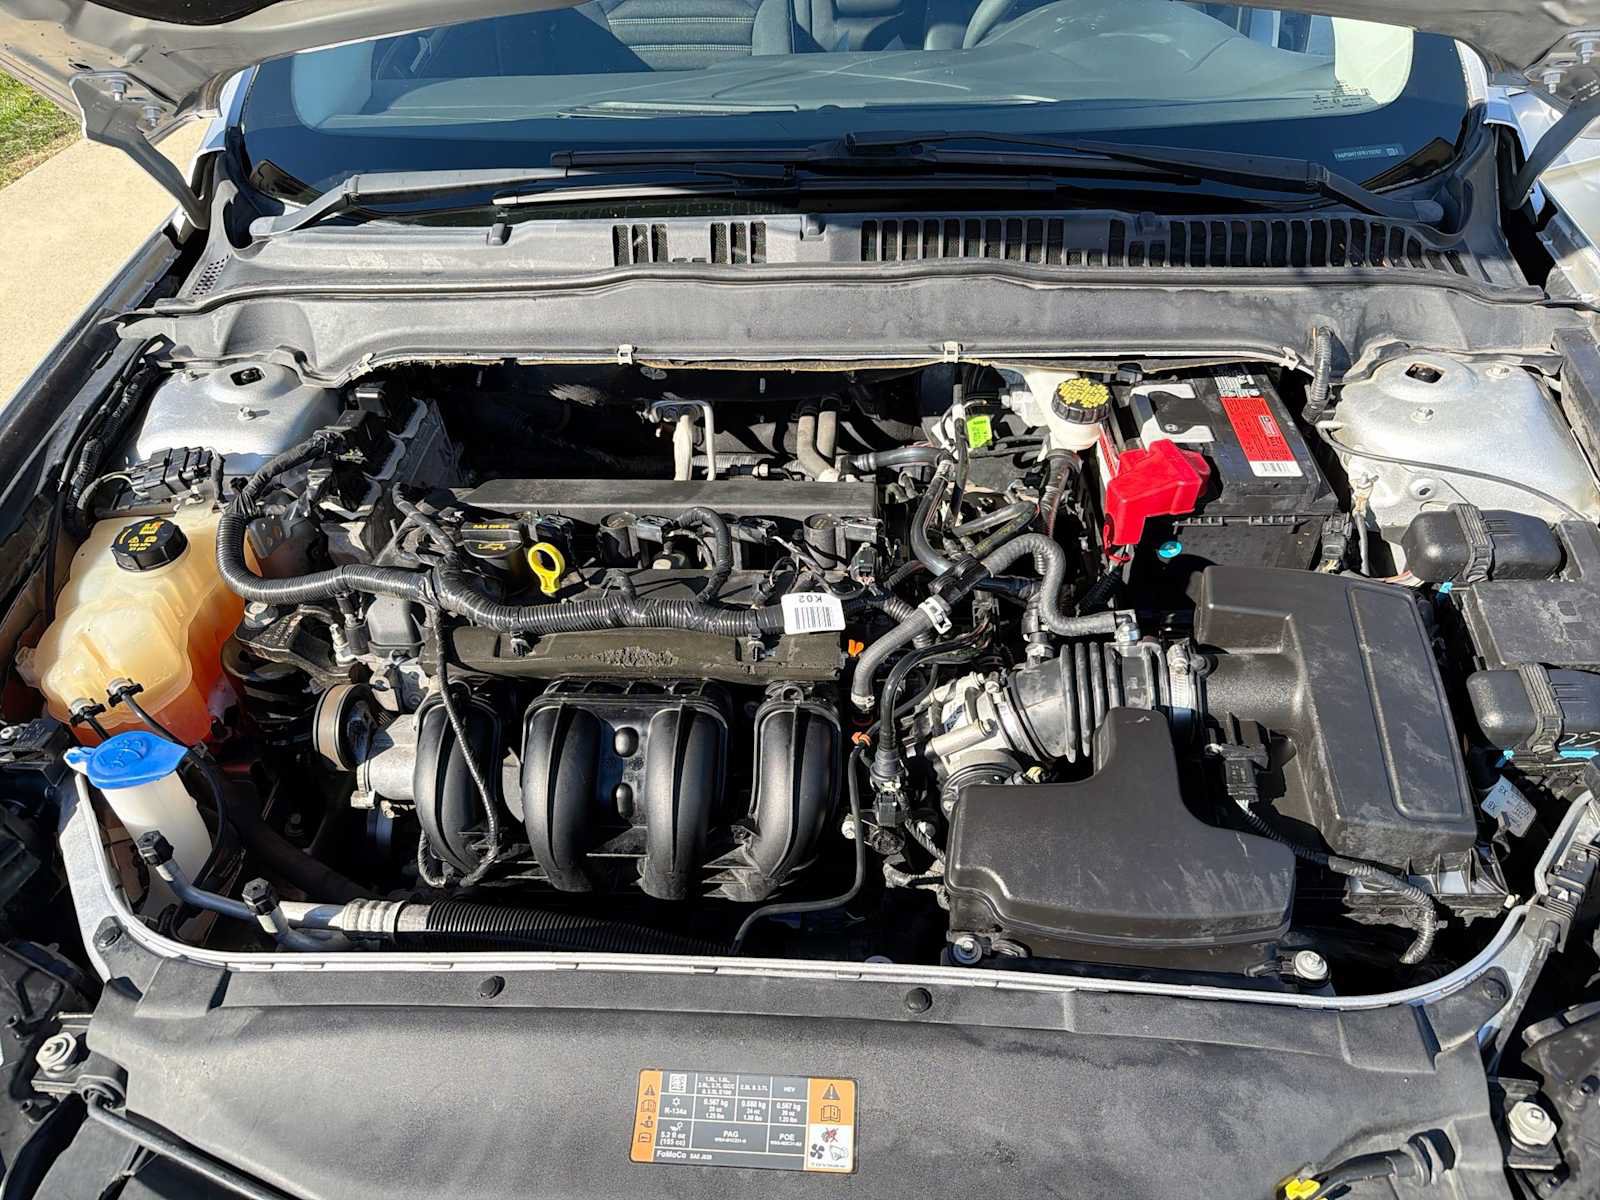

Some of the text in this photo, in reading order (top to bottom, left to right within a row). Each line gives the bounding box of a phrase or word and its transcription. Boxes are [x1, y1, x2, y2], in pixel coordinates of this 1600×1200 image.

[798, 594, 822, 603] K02
[664, 1107, 687, 1115] R-134a
[778, 1133, 795, 1141] POE
[656, 1150, 687, 1158] FoMoCo
